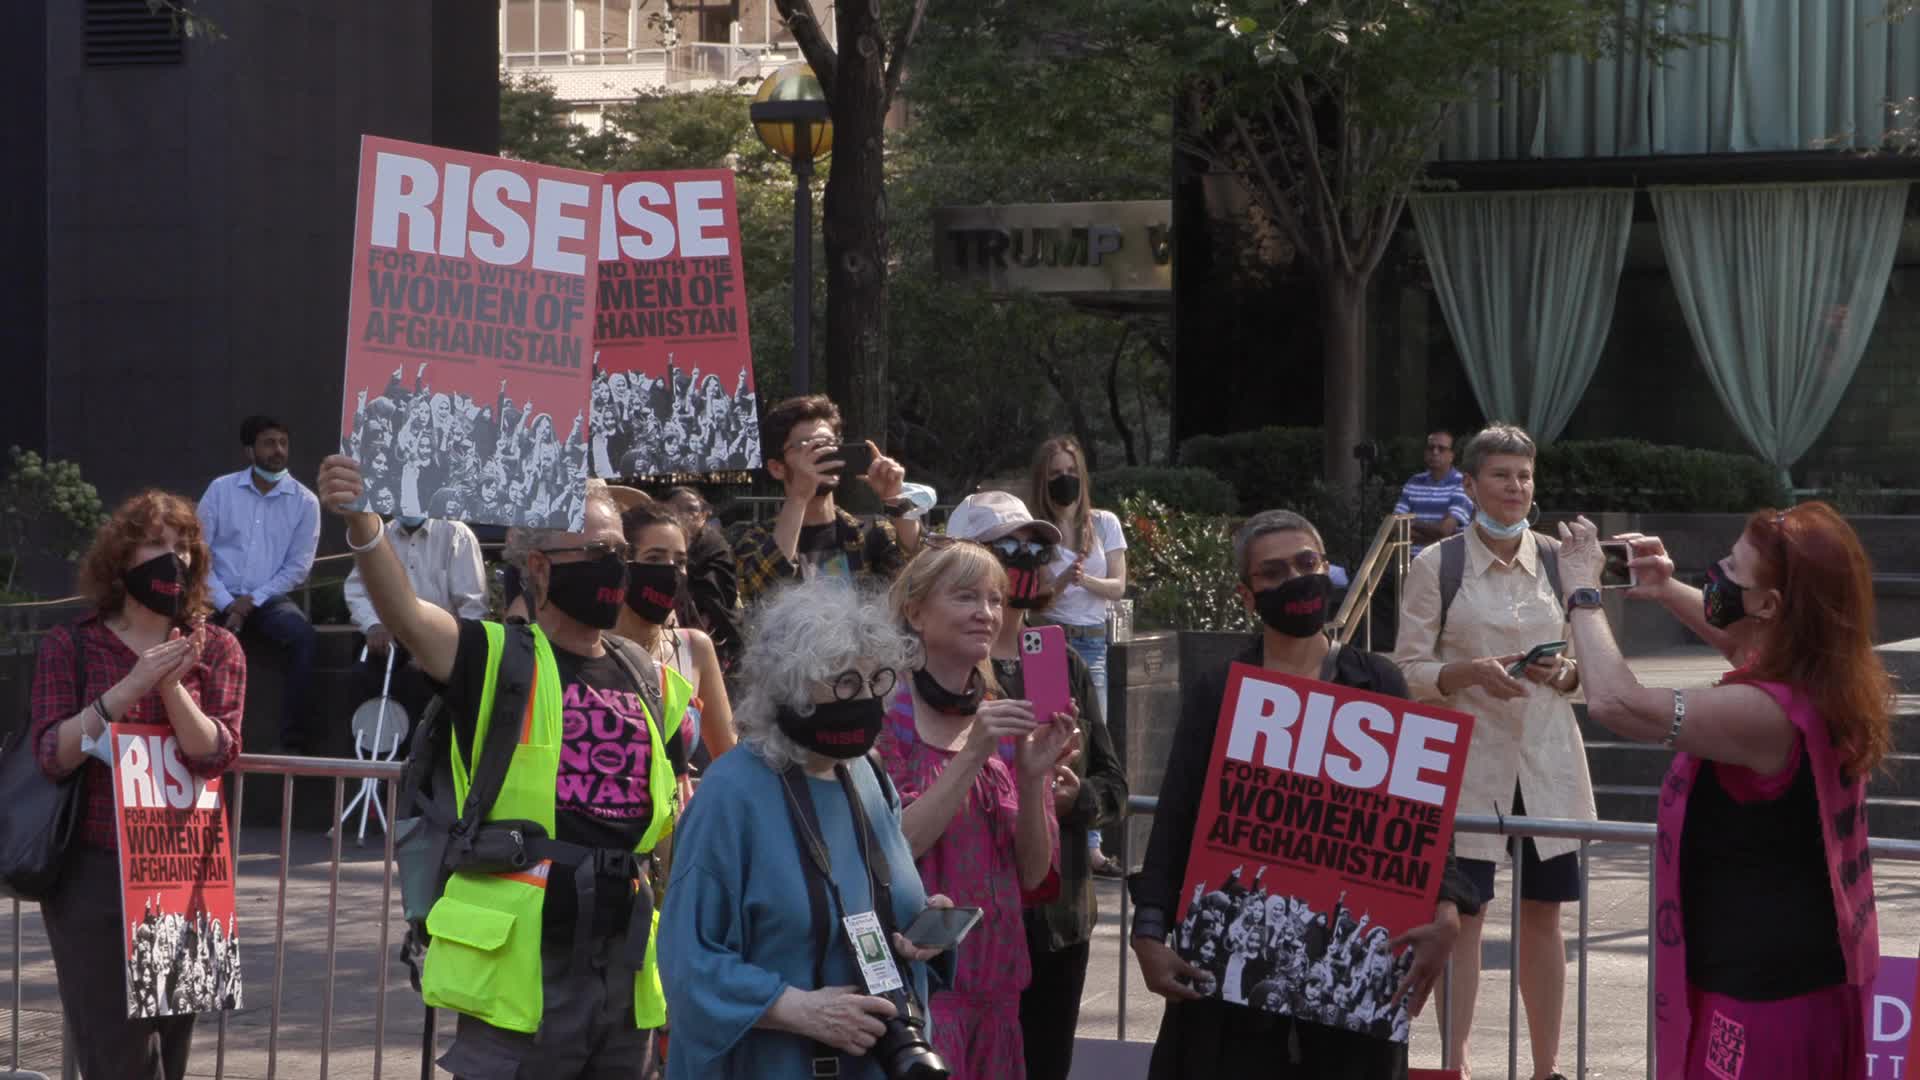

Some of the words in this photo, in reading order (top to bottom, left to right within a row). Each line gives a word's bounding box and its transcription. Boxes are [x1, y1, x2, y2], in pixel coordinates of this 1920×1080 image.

[370, 151, 590, 276] RISE
[598, 180, 730, 261] ISE
[598, 262, 627, 278] ND
[633, 260, 687, 276] WITH
[692, 257, 732, 273] THE
[948, 227, 1122, 268] TRUMP
[368, 249, 417, 272] FOR
[423, 256, 472, 281] AND
[478, 264, 536, 289] WITH
[542, 273, 585, 297] THE
[597, 276, 683, 311] MEN
[688, 274, 735, 306] OF
[368, 269, 529, 328] WOMEN
[534, 293, 585, 333] OF
[594, 306, 738, 339] HANISTAN
[363, 311, 584, 369] AFGHANISTAN
[560, 741, 651, 777] NOT
[1225, 676, 1459, 806] RISE
[125, 809, 148, 824] FOR
[150, 809, 171, 825] AND
[175, 809, 200, 825] WITH
[202, 810, 222, 825] THE
[1219, 777, 1379, 846] WOMEN
[1383, 817, 1440, 857] OF
[1222, 761, 1270, 786] FOR
[1274, 772, 1325, 797] AND
[1330, 785, 1390, 813] WITH
[1394, 798, 1443, 825] THE
[126, 825, 200, 855] WOMEN
[203, 825, 225, 855] OF
[1207, 814, 1431, 890] AFGHANISTAN
[129, 856, 228, 882] AFGHANISTAN
